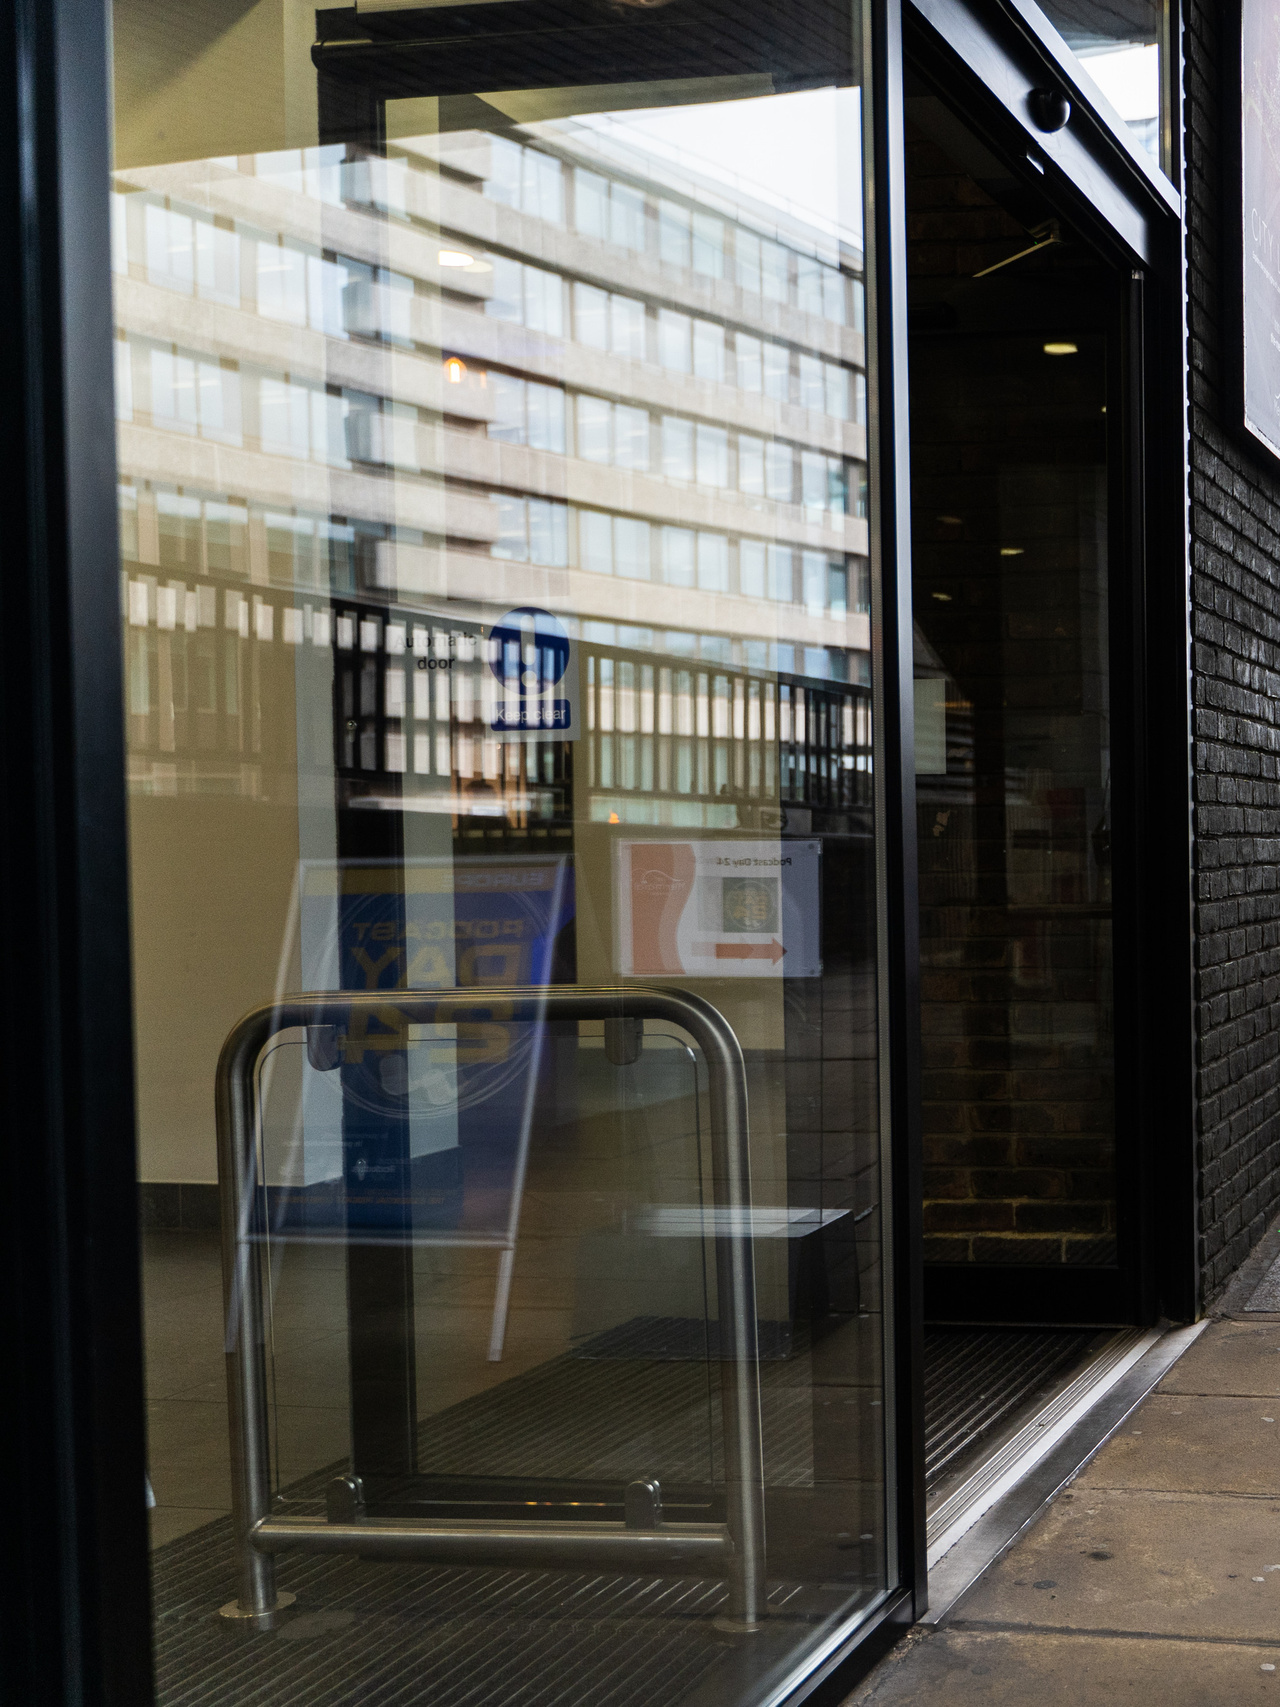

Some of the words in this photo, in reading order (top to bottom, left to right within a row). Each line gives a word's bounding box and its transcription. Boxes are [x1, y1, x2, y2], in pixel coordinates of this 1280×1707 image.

[1251, 207, 1274, 262] CITY
[417, 656, 455, 670] door
[497, 709, 528, 723] Keep
[533, 708, 566, 721] clear
